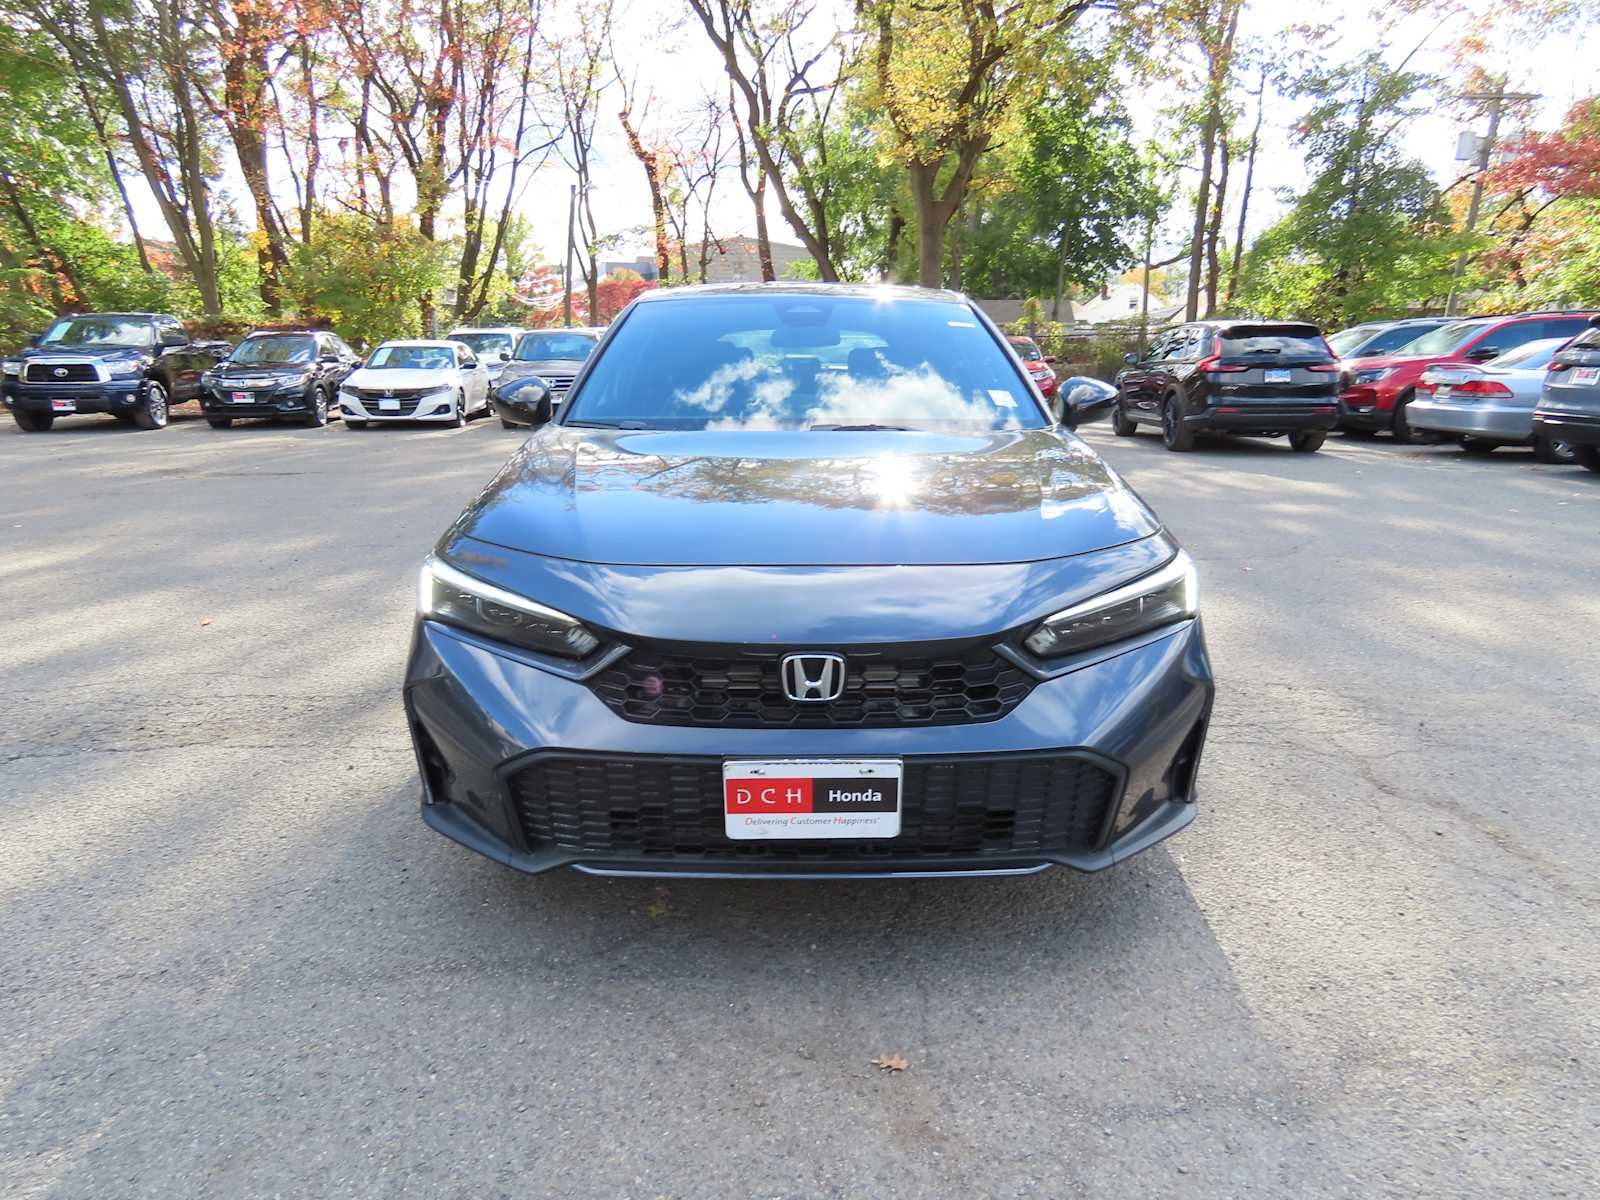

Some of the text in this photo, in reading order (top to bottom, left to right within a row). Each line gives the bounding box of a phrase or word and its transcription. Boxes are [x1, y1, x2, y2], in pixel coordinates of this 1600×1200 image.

[828, 789, 882, 802] Honda
[745, 817, 788, 827] Delivering
[790, 816, 831, 826] Customer
